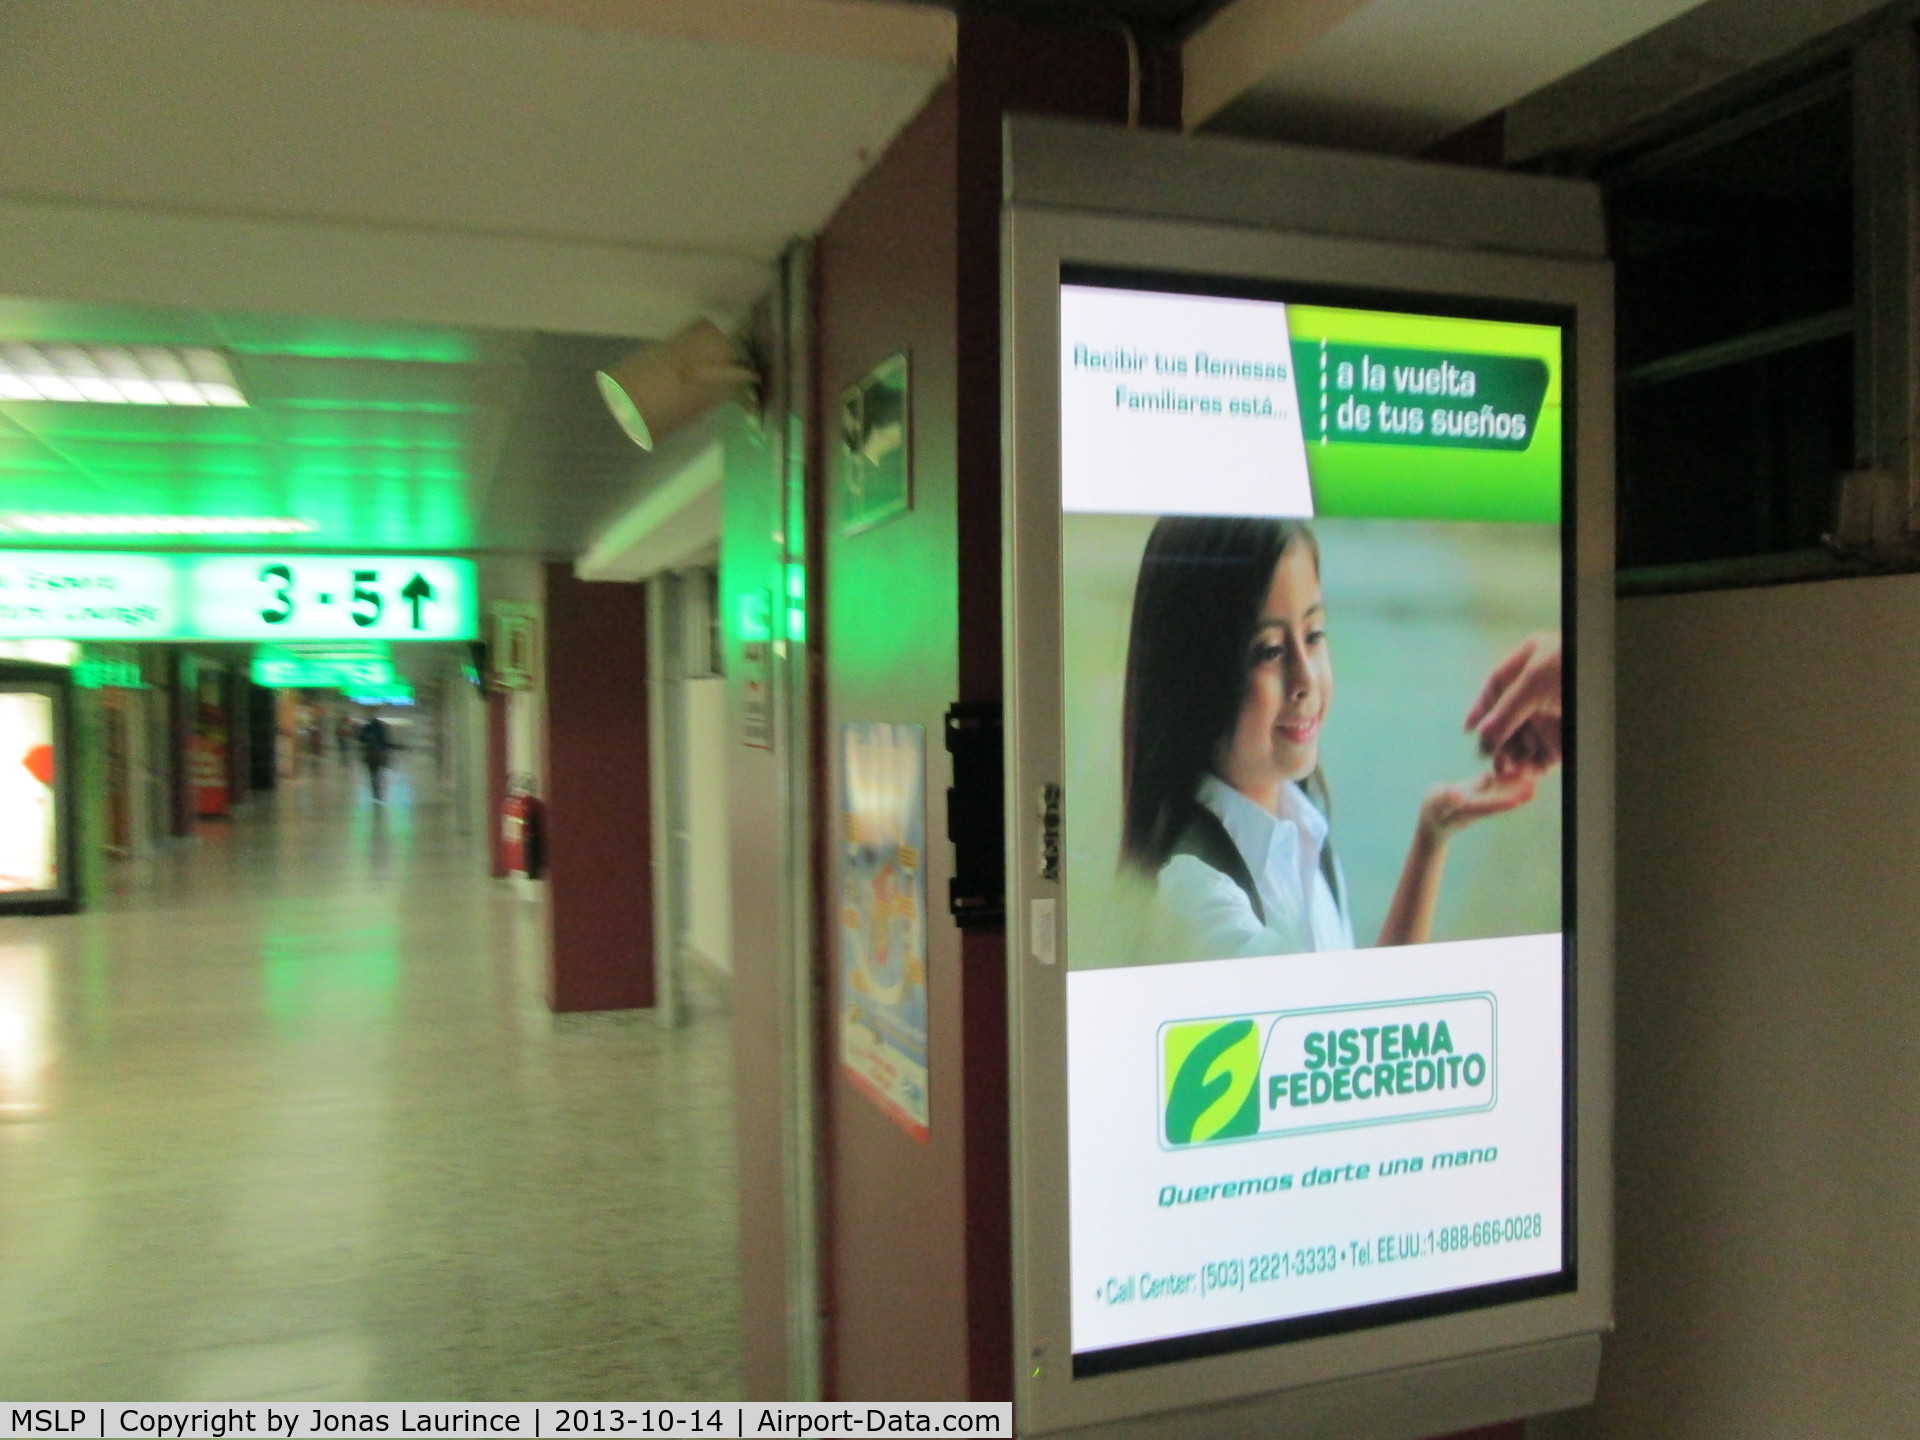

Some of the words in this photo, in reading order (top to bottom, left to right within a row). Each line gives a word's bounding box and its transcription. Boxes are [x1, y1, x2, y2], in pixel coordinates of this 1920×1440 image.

[1073, 343, 1148, 373] Recibir
[1155, 353, 1188, 375] tus
[1195, 352, 1288, 381] Remesas
[1337, 361, 1354, 391] a
[1361, 354, 1387, 393] la
[1393, 360, 1477, 398] vuelta
[1115, 384, 1223, 414] Familiares
[1337, 394, 1372, 433] de
[1378, 400, 1425, 436] tus
[1431, 404, 1527, 441] sueños
[1303, 1019, 1455, 1070] SISTEMA
[1268, 1052, 1487, 1110] FEDECREDITO
[1157, 1174, 1293, 1208] Queremos
[1301, 1162, 1371, 1188] darte
[1378, 1156, 1425, 1177] una
[1431, 1146, 1498, 1170] mano
[1106, 1276, 1135, 1305] Call
[1201, 1258, 1244, 1297] (503)
[1249, 1244, 1337, 1284] 2221-3333
[1350, 1240, 1374, 1267] Tel.
